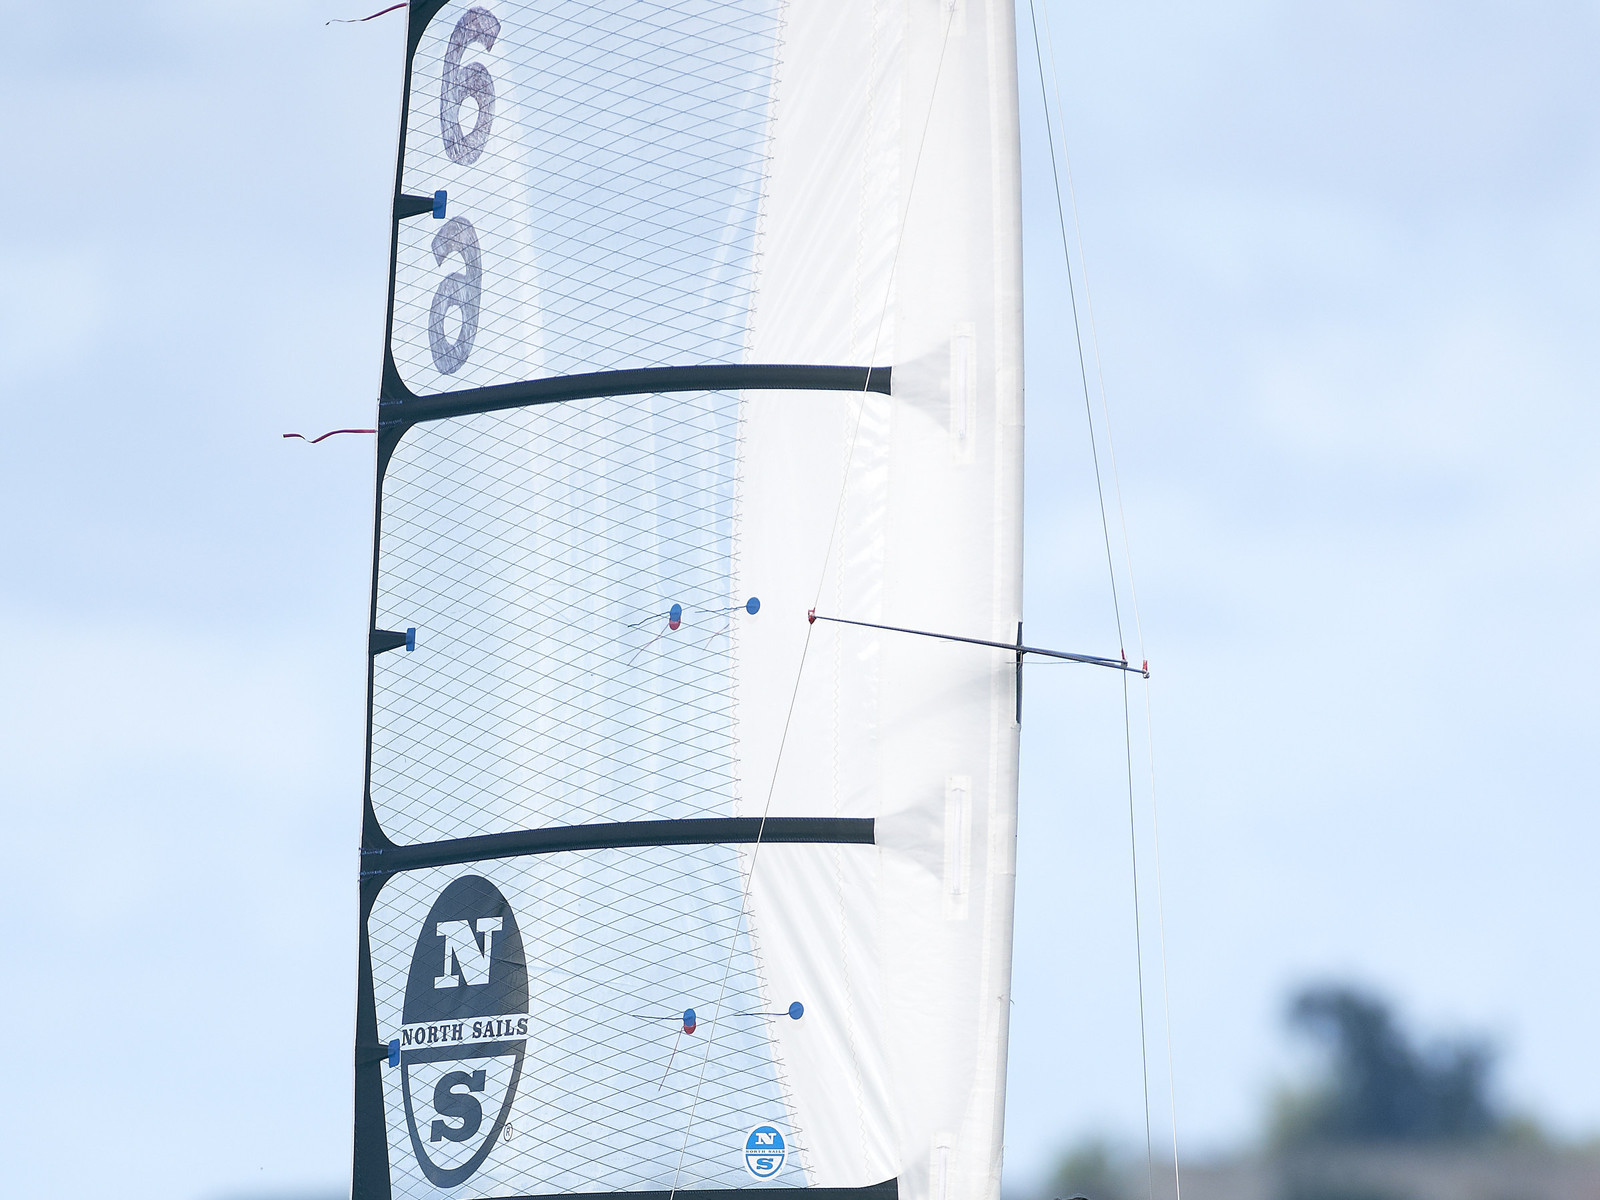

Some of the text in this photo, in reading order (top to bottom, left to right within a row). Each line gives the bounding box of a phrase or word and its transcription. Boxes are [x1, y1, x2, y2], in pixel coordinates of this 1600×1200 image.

[440, 6, 501, 166] 6
[434, 916, 503, 989] N
[402, 1018, 529, 1046] NORTH SAILS
[430, 1069, 487, 1143] S
